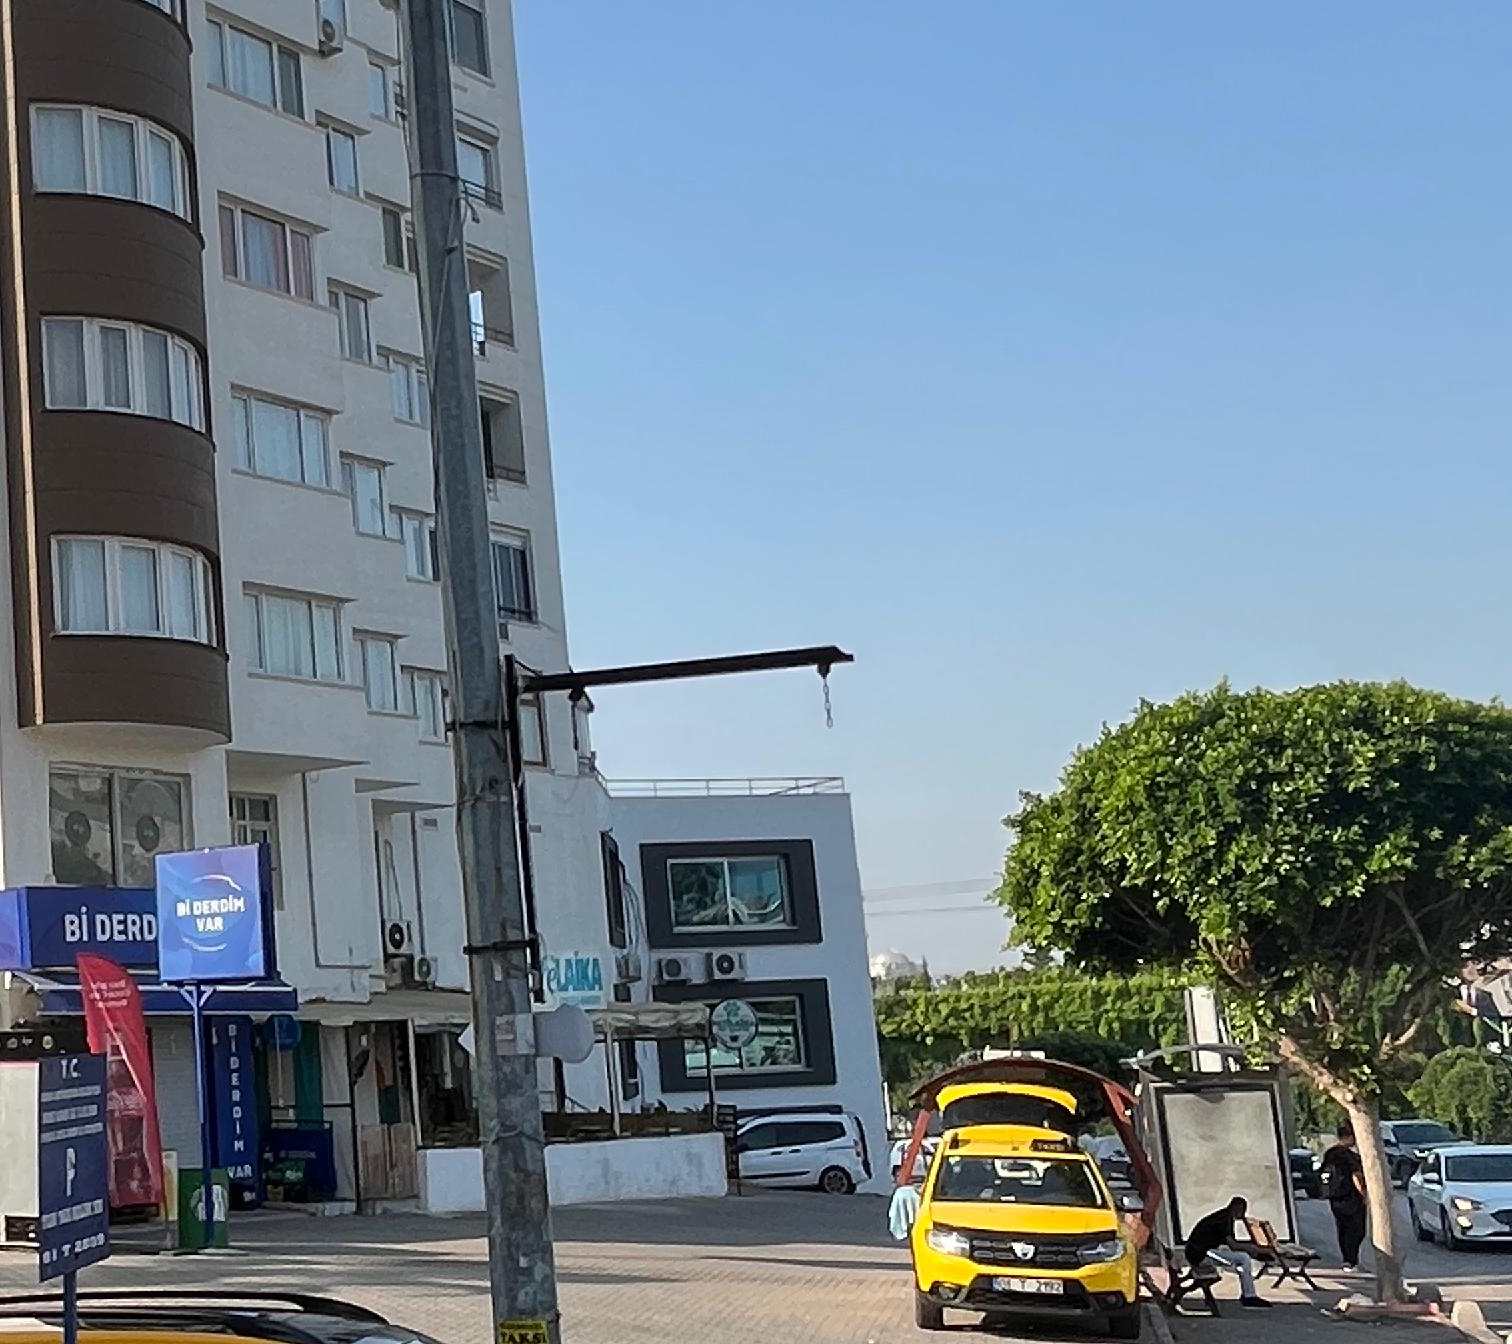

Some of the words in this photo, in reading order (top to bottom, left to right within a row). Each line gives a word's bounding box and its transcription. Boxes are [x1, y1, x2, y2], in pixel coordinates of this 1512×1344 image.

[192, 894, 246, 916] DERDİM
[95, 913, 158, 943] DERD
[196, 917, 224, 932] VAR
[227, 1164, 253, 1180] VAR
